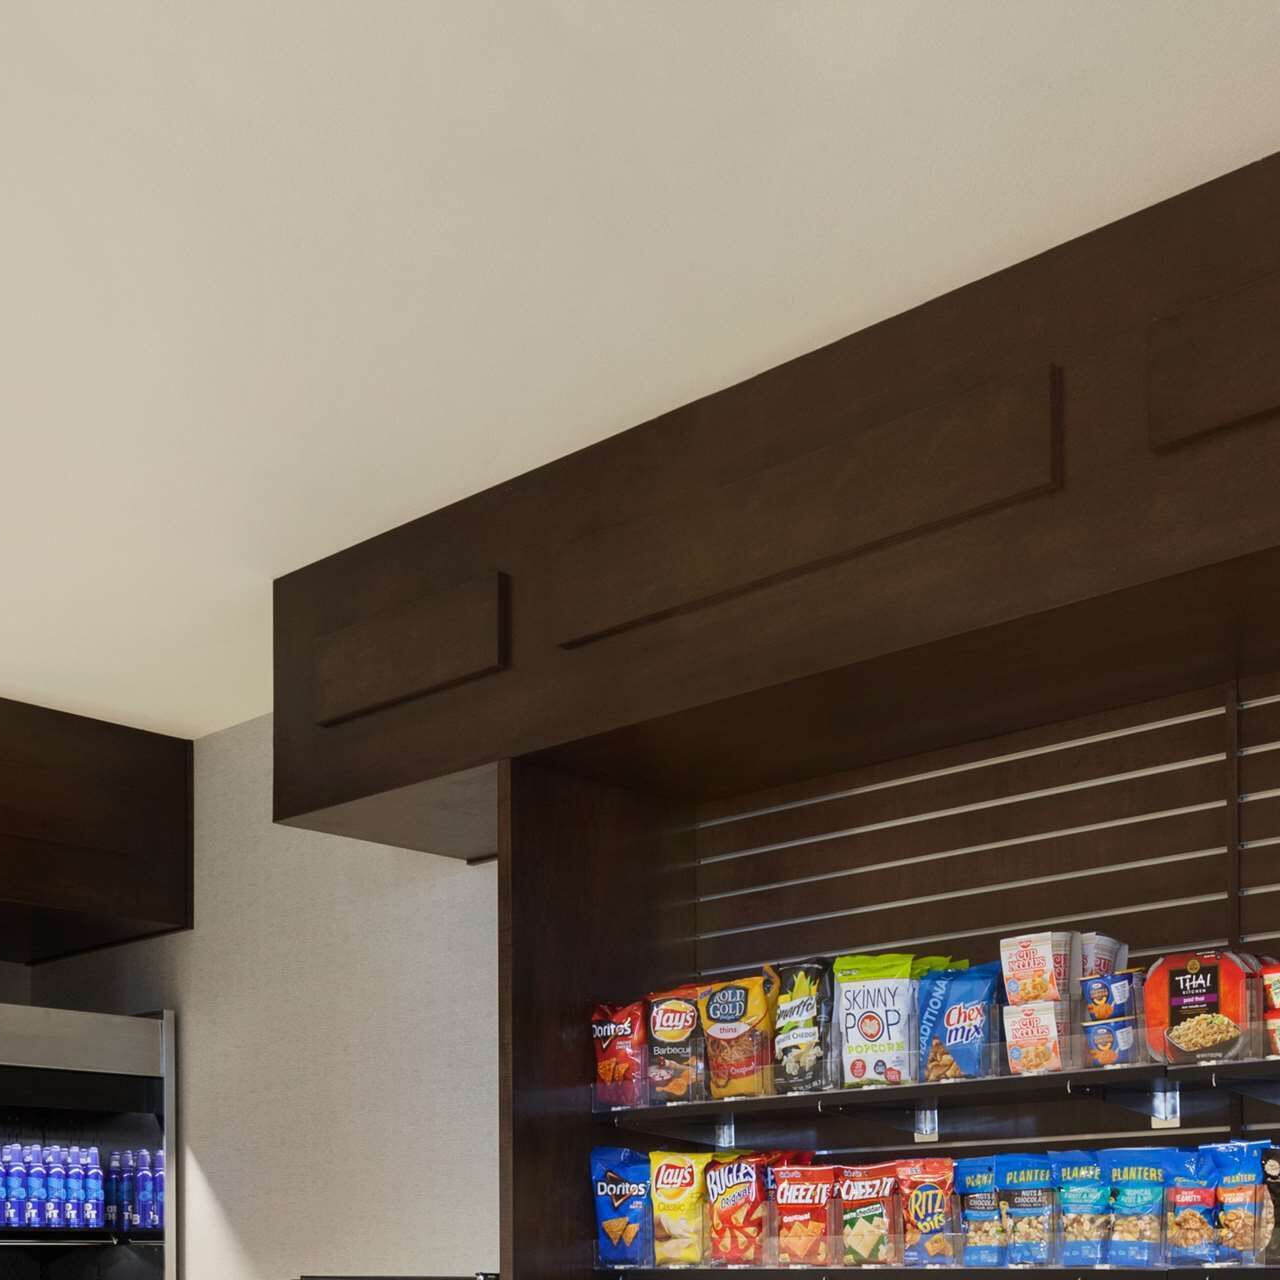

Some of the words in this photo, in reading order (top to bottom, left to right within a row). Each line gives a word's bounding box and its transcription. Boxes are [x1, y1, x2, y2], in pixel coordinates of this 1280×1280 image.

[1008, 957, 1047, 969] NOODLES
[1016, 948, 1037, 960] CUP
[1175, 974, 1211, 991] THAI
[713, 988, 744, 1003] ROLD
[844, 986, 899, 1010] SKINNY
[656, 1008, 695, 1031] Lay's
[709, 1001, 744, 1019] GOLD
[945, 1001, 984, 1027] Chex
[592, 1020, 631, 1039] Doritos
[845, 1009, 900, 1042] POP
[1020, 1017, 1040, 1029] CUP
[946, 1024, 983, 1046] mix
[848, 1041, 905, 1054] POPCORN
[656, 1165, 694, 1189] Lay's
[706, 1164, 756, 1202] BUGLES
[1112, 1167, 1163, 1181] PLANTERS
[597, 1181, 647, 1197] Doritos
[909, 1189, 944, 1218] RITZ
[916, 1214, 945, 1233] bits
